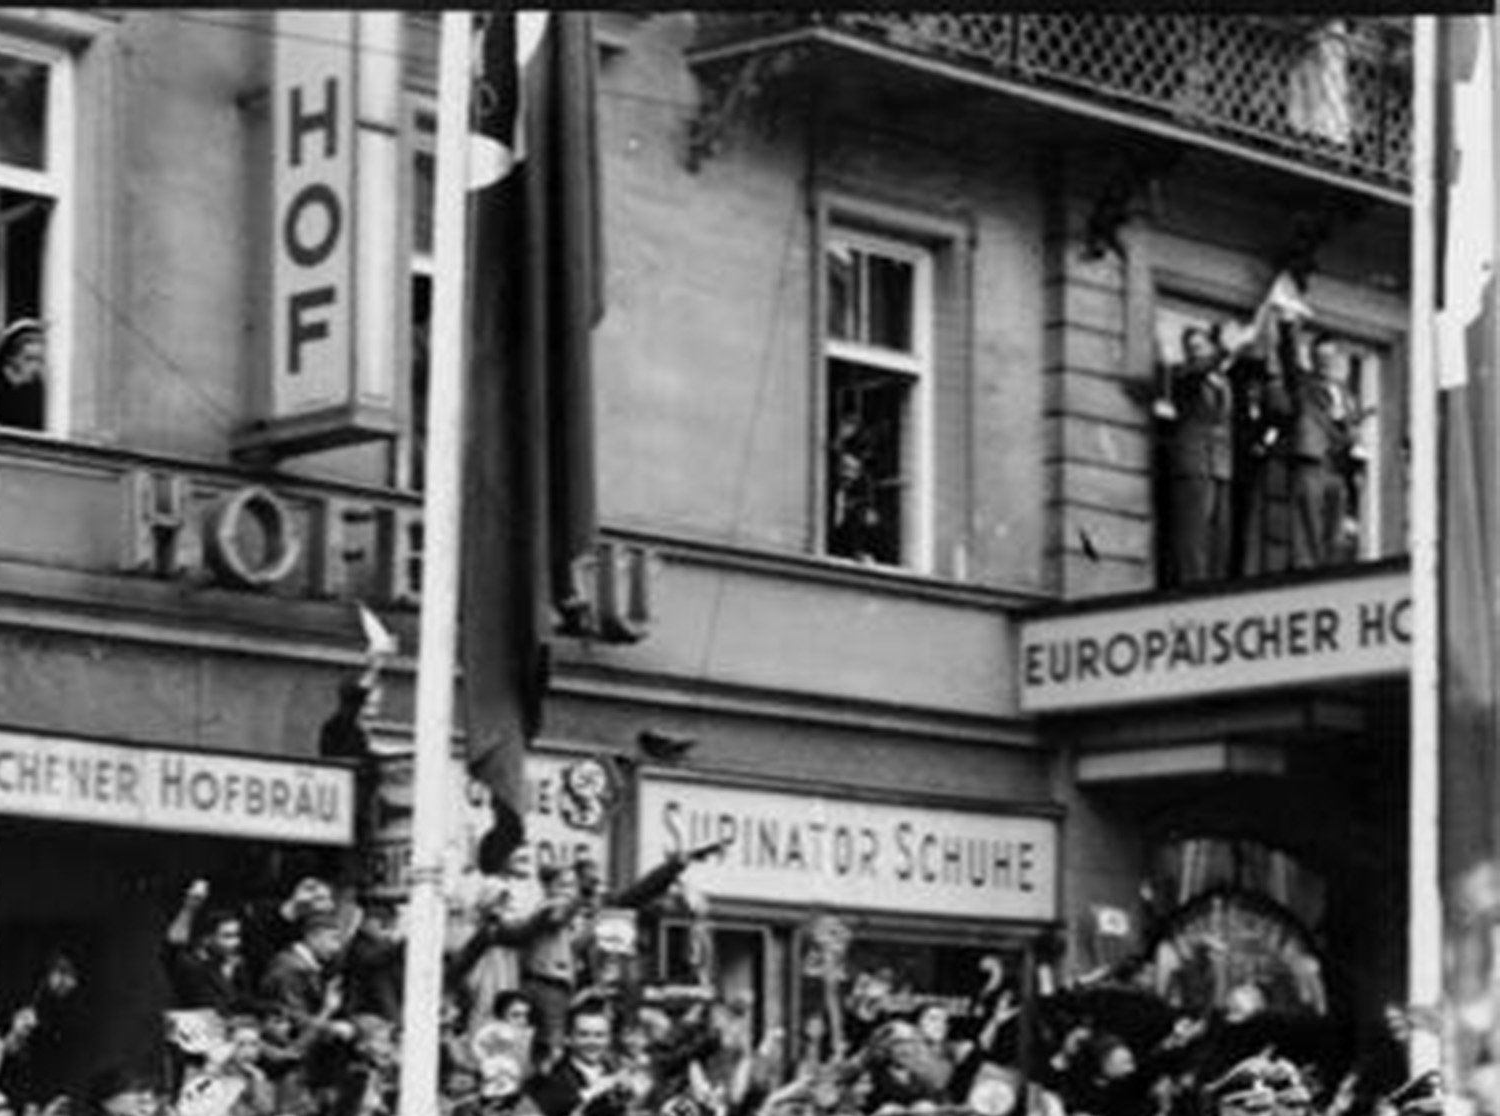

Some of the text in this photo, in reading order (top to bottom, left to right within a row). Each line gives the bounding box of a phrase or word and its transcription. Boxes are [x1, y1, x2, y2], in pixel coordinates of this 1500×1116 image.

[285, 76, 342, 375] HOF
[1024, 607, 1341, 686] EUROPÄISCHER
[158, 756, 340, 824] HOFBRÄU
[662, 800, 880, 878] SUPINATOR
[896, 821, 1034, 894] SCHUHE
